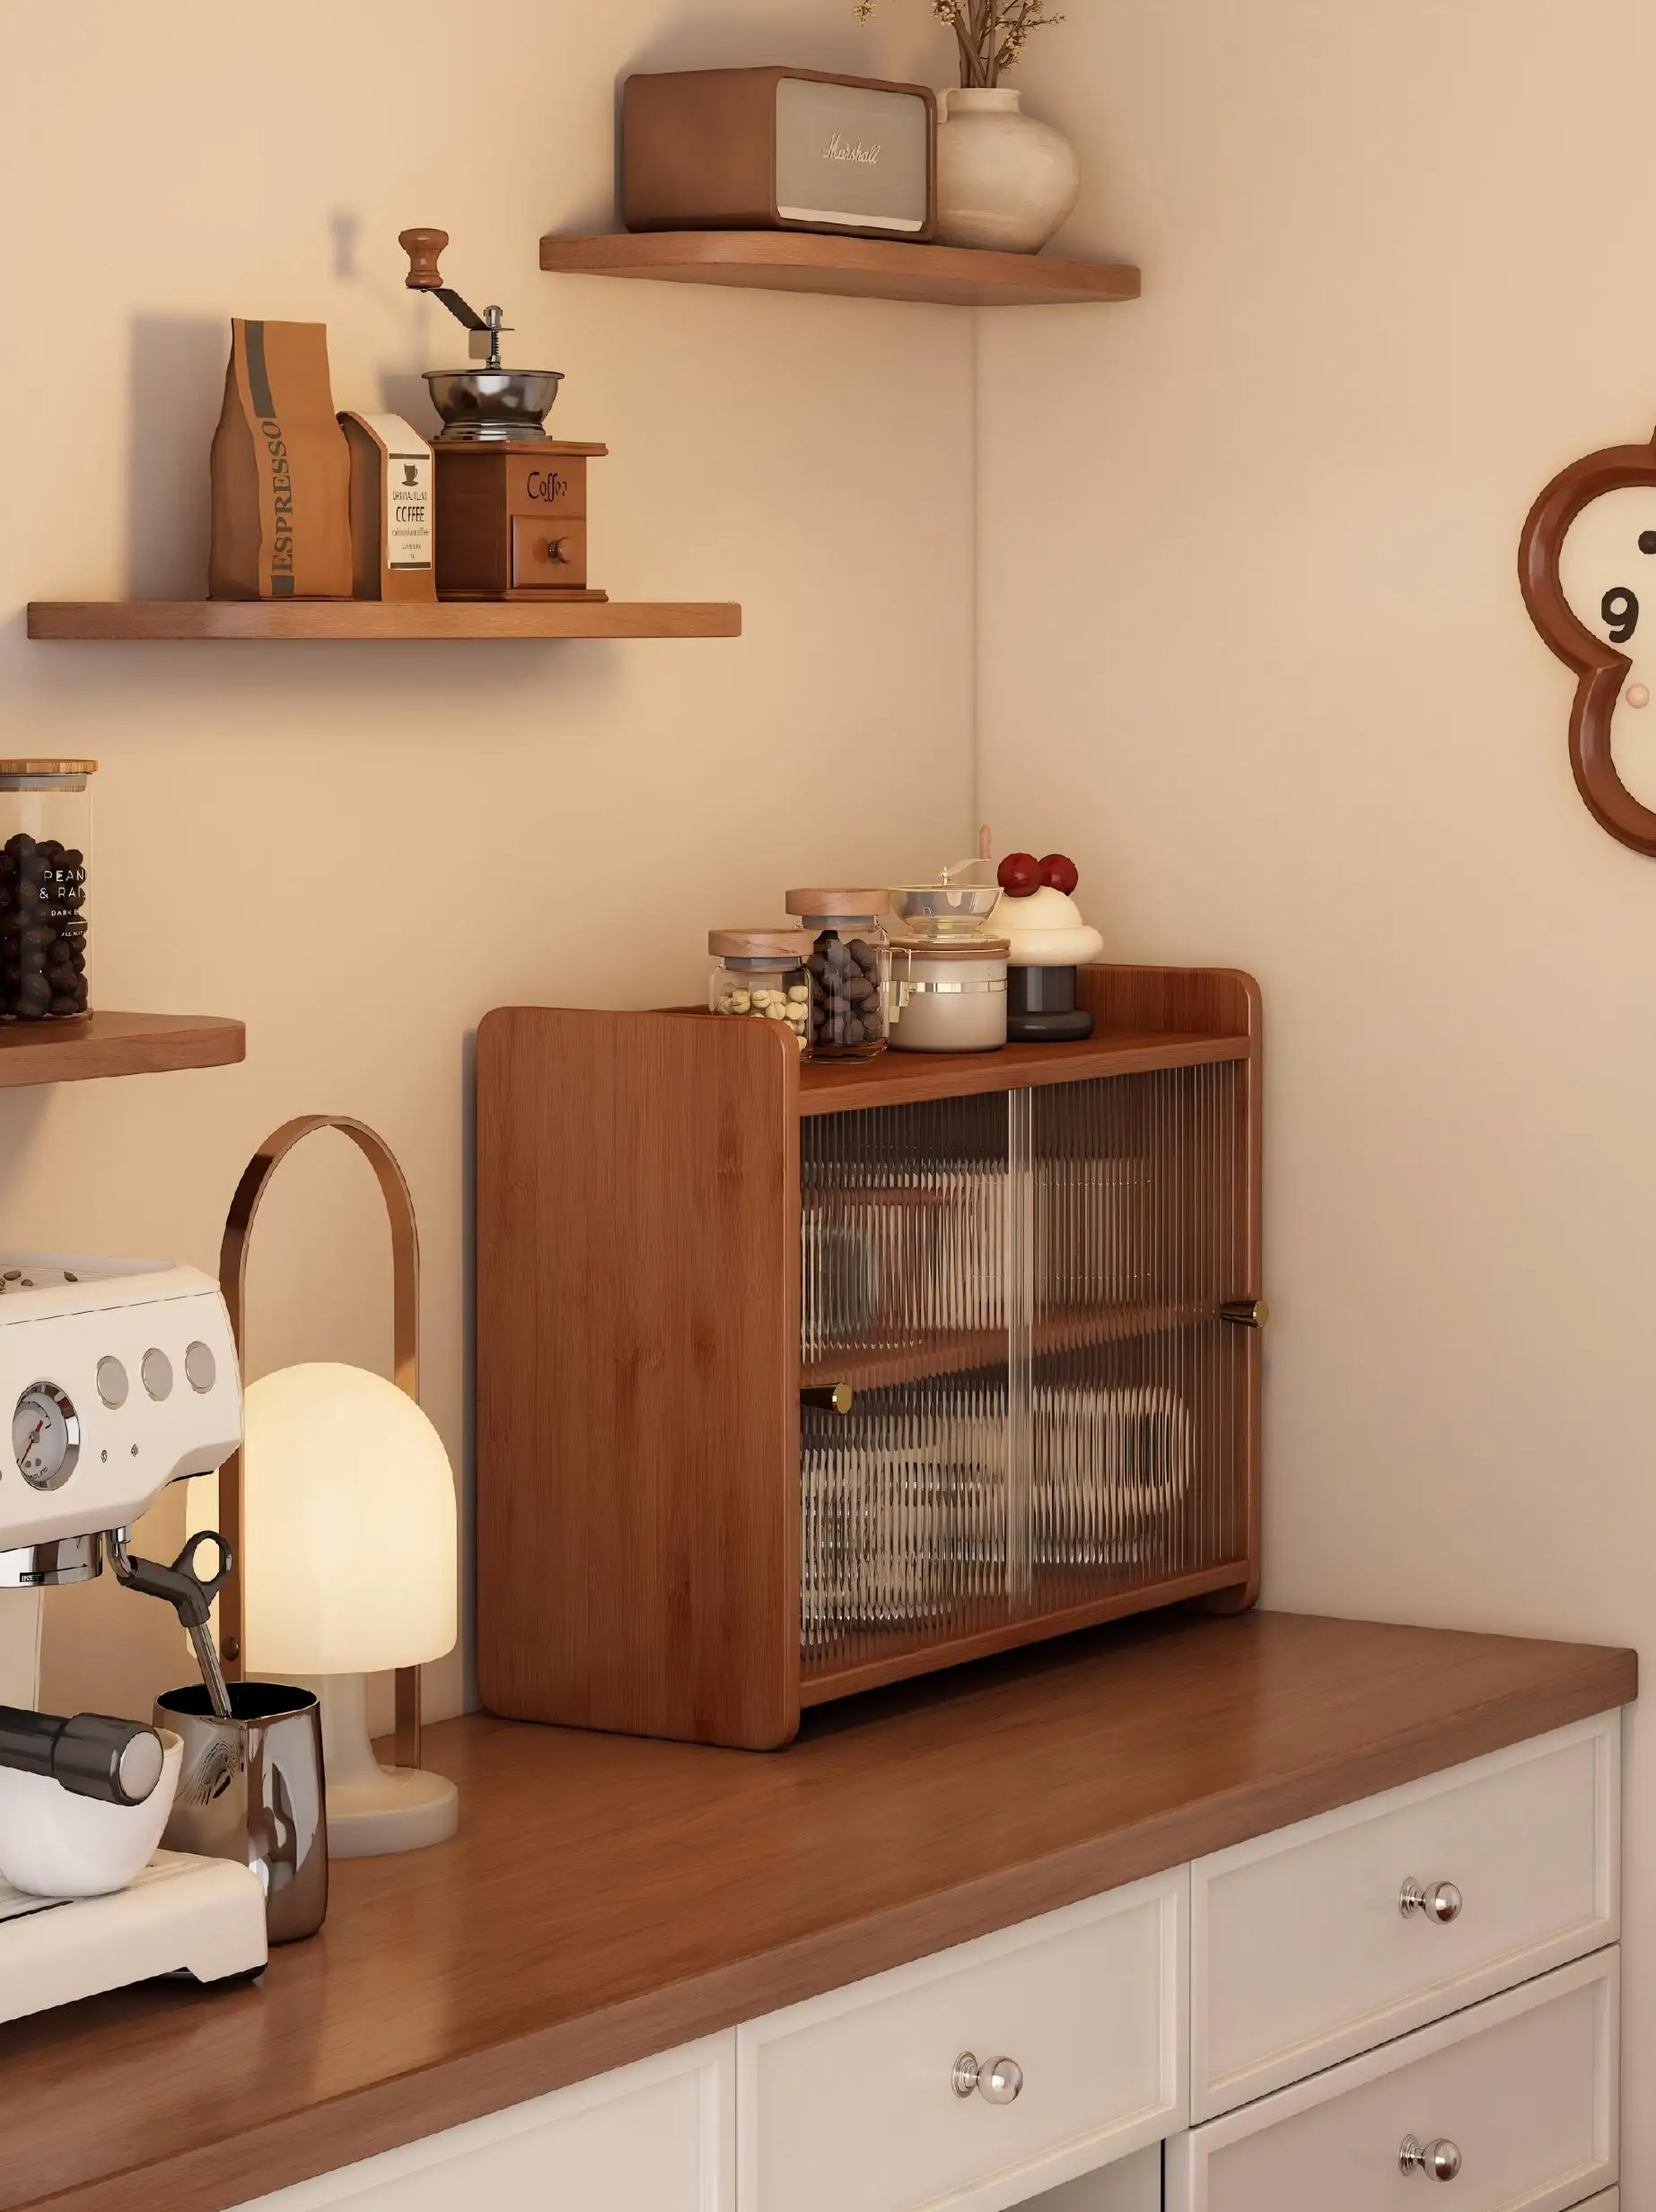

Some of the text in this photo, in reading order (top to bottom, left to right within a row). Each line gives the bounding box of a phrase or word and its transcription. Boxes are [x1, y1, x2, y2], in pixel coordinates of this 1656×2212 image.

[822, 131, 881, 164] Marshall
[261, 421, 294, 573] ESPRESSO
[396, 506, 425, 522] COFFEE
[1601, 586, 1639, 643] 9
[43, 870, 87, 882] PEAN
[39, 886, 86, 899] & RAI
